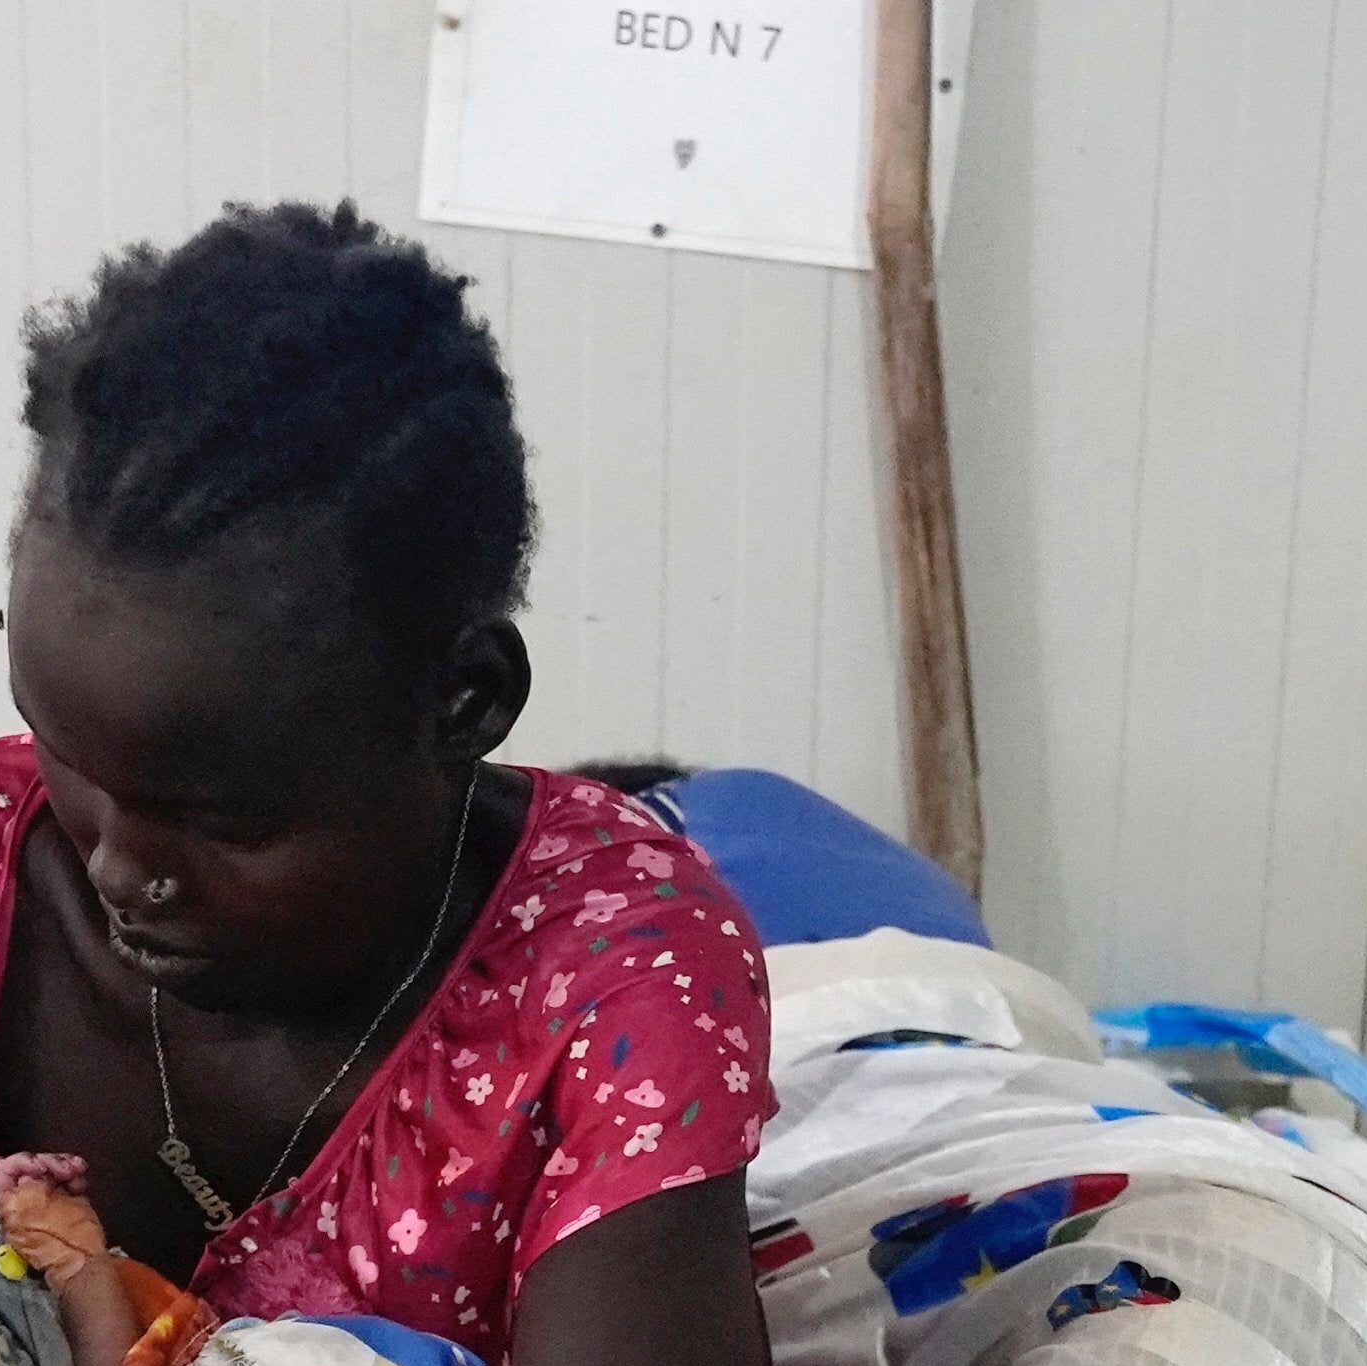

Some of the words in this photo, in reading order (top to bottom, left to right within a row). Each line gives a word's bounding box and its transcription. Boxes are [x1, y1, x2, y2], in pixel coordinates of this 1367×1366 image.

[615, 10, 693, 51] BED
[710, 20, 741, 58] N
[762, 25, 783, 62] 7
[157, 1138, 234, 1232] Beauty
